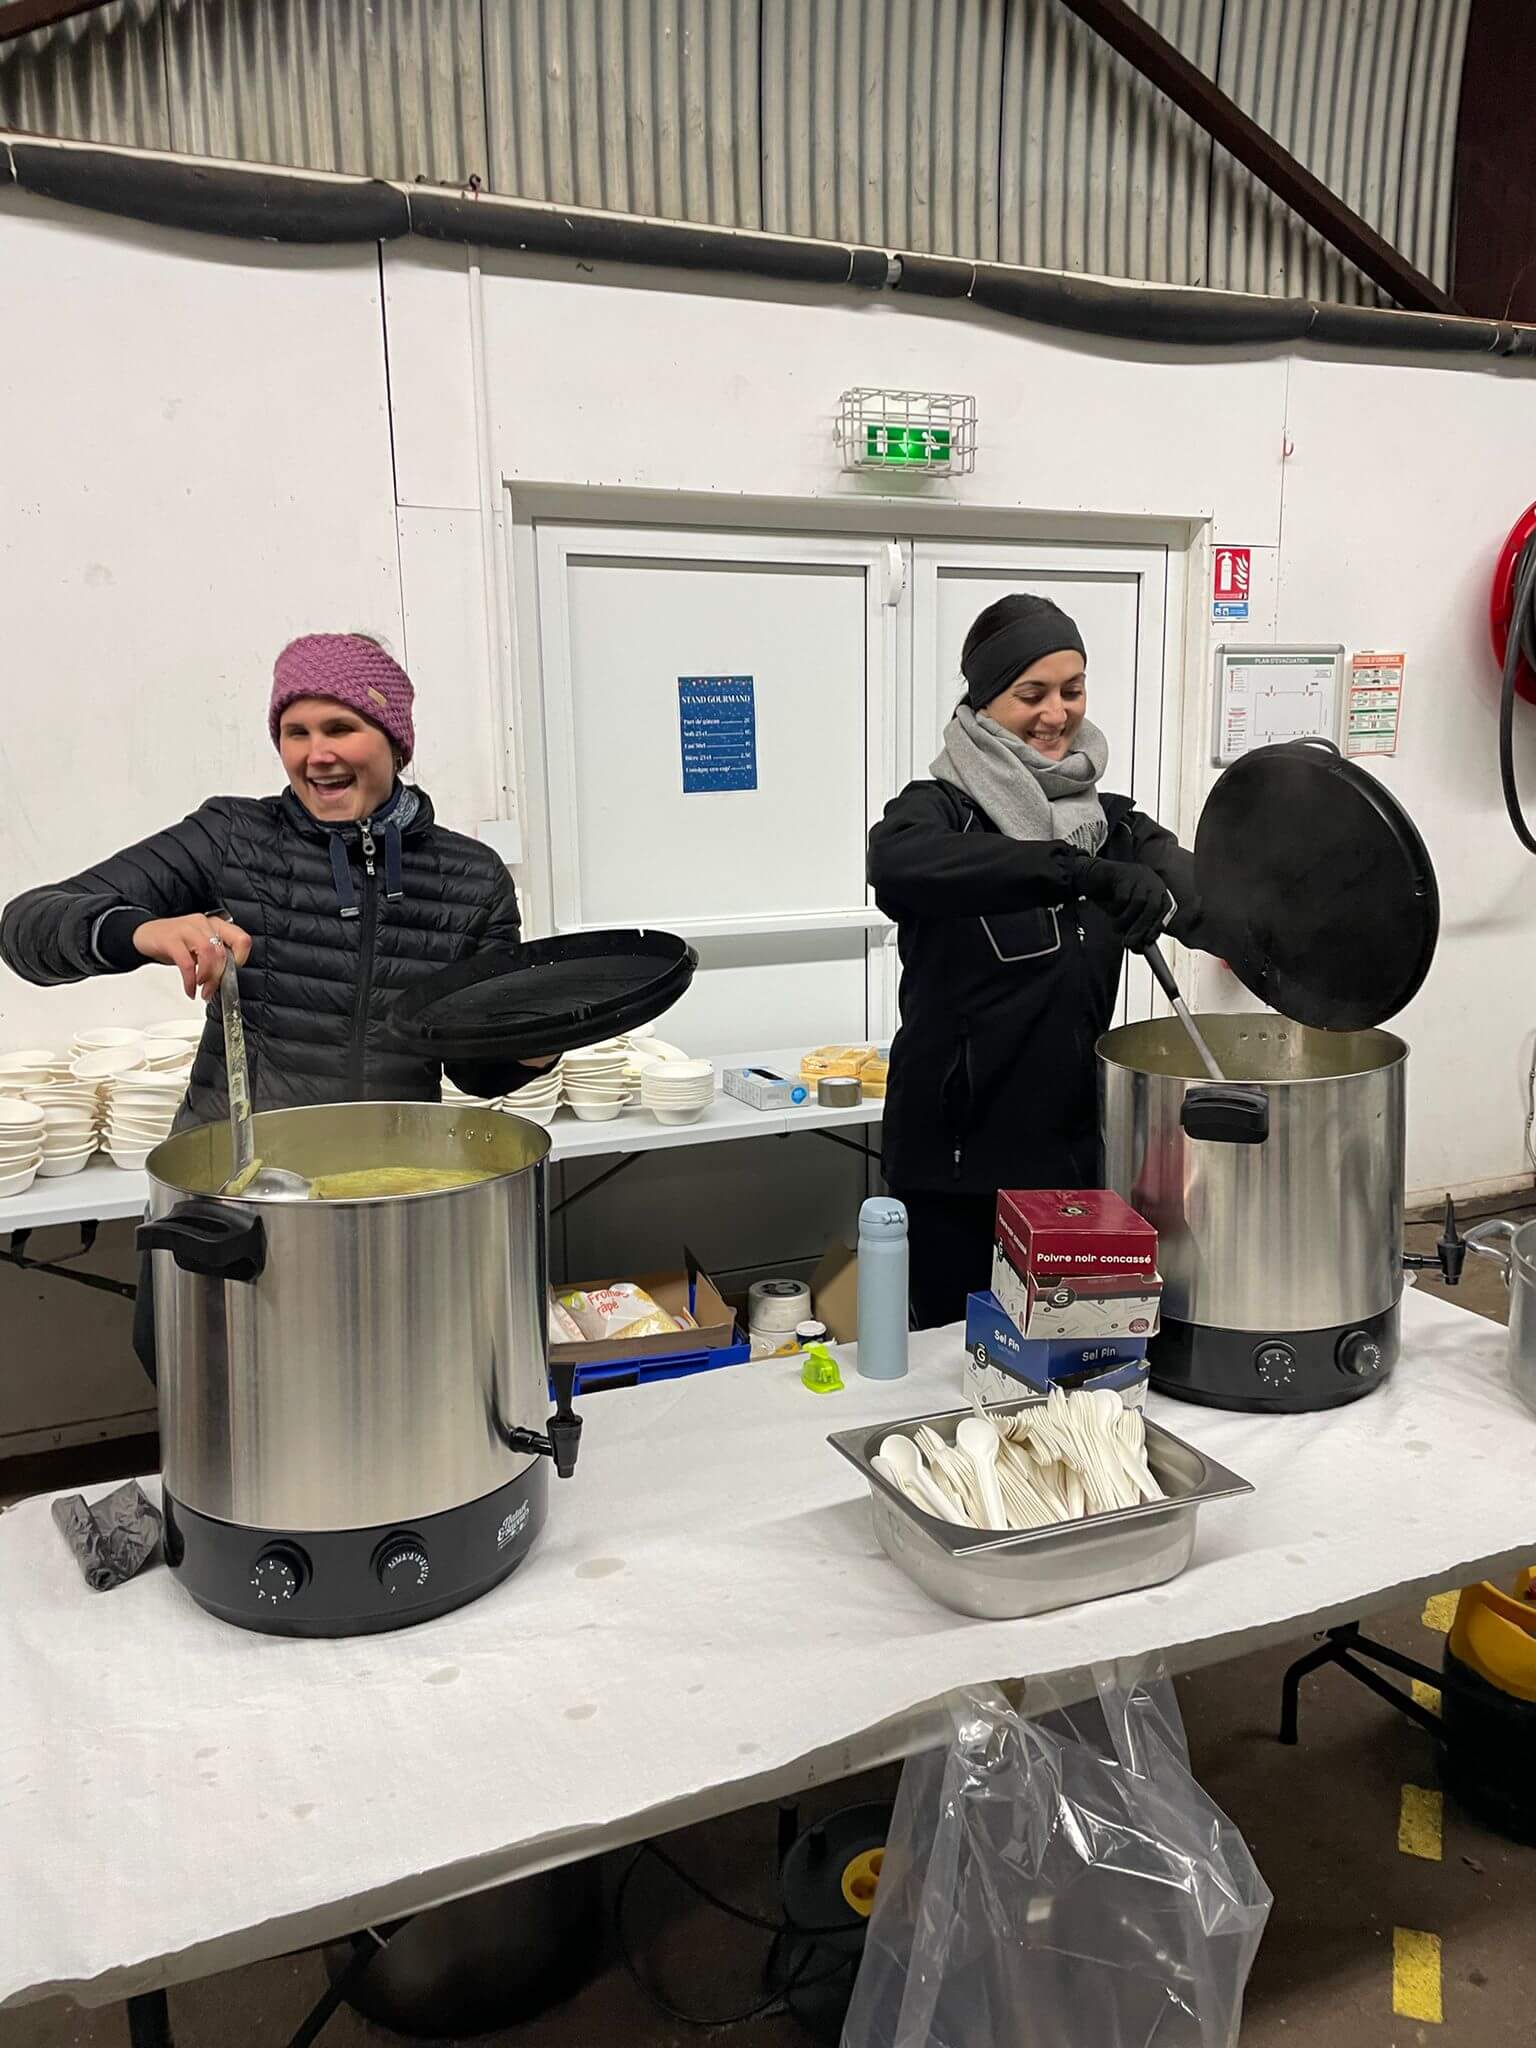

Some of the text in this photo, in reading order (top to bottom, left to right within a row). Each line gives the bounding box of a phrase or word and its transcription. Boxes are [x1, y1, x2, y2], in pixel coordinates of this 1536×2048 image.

[682, 695, 750, 704] STAND GOURMAND
[1036, 1253, 1152, 1265] Poivre noir concassé
[993, 1329, 1007, 1345] Sel
[1007, 1336, 1021, 1353] Fin
[1081, 1346, 1117, 1362] Sel Fin
